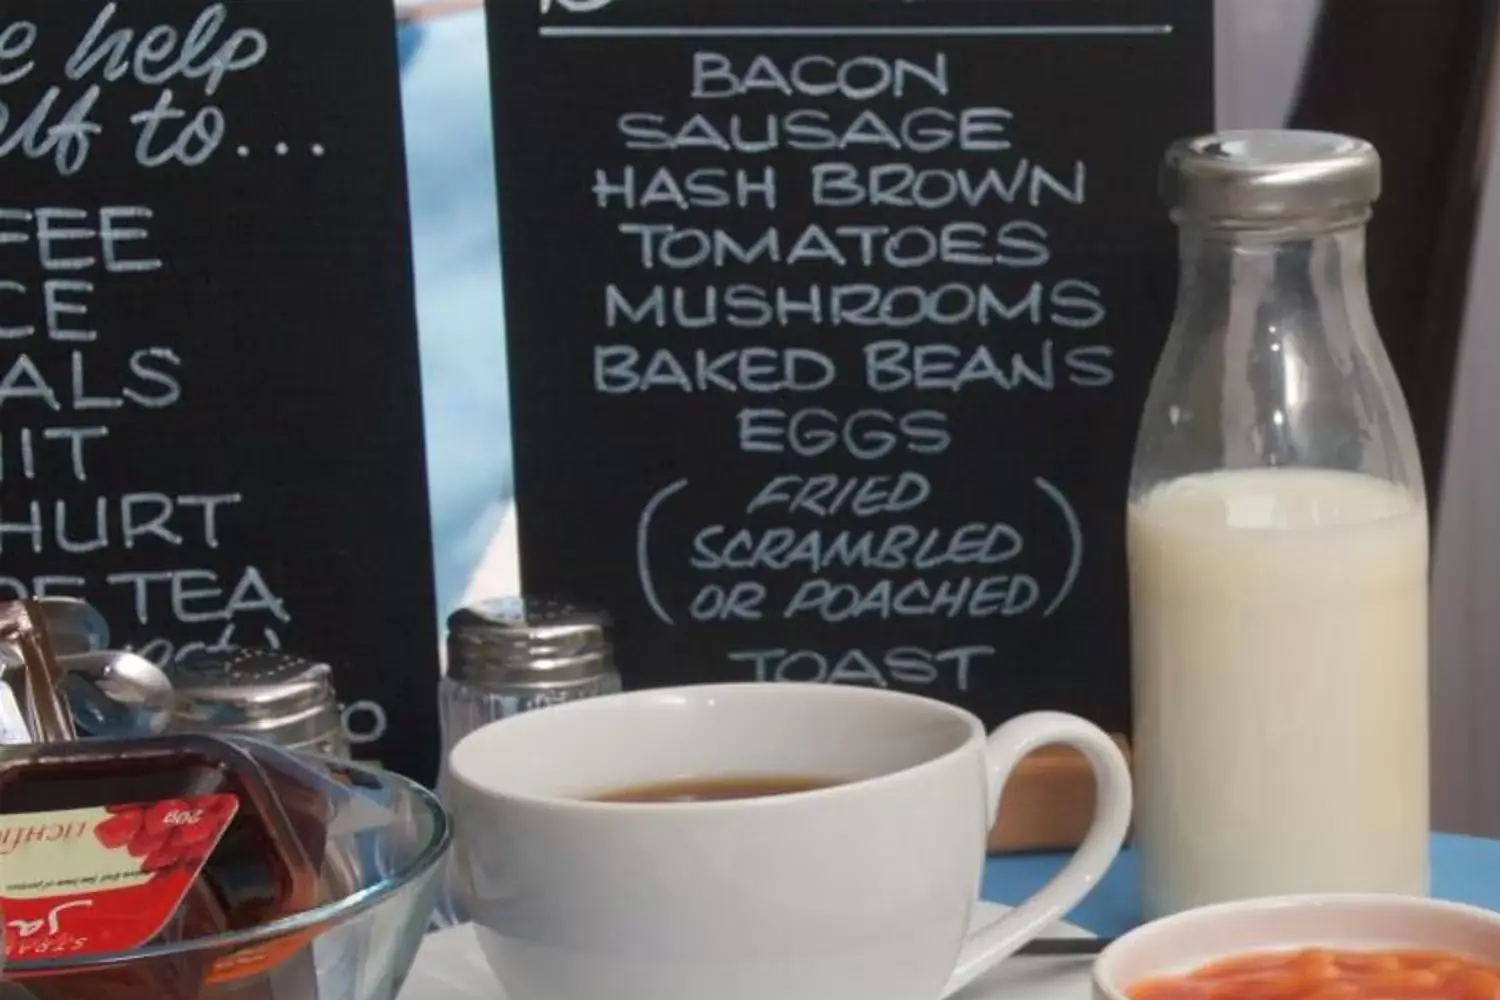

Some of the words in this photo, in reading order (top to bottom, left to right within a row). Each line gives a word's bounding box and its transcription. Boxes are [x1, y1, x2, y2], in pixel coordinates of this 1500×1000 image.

[65, 2, 267, 98] help
[691, 52, 948, 99] BACON
[0, 84, 101, 174] lf
[619, 107, 1013, 152] SAUSAGE
[592, 166, 775, 209] HASH
[812, 159, 1084, 208] BROWN
[619, 221, 1049, 268] TOMATOES
[606, 279, 1104, 327] MUSHROOMS
[0, 348, 180, 410] ALS
[595, 346, 835, 392] BAKED
[864, 340, 1112, 391] BEANS
[0, 426, 108, 480] IT
[737, 408, 950, 459] EGGS
[747, 472, 929, 515] FRIED
[692, 524, 1021, 572] SCRAMBLED
[107, 566, 290, 625] TEA
[692, 582, 765, 619] OR
[784, 576, 1038, 621] POACHED
[729, 646, 994, 691] TOAST
